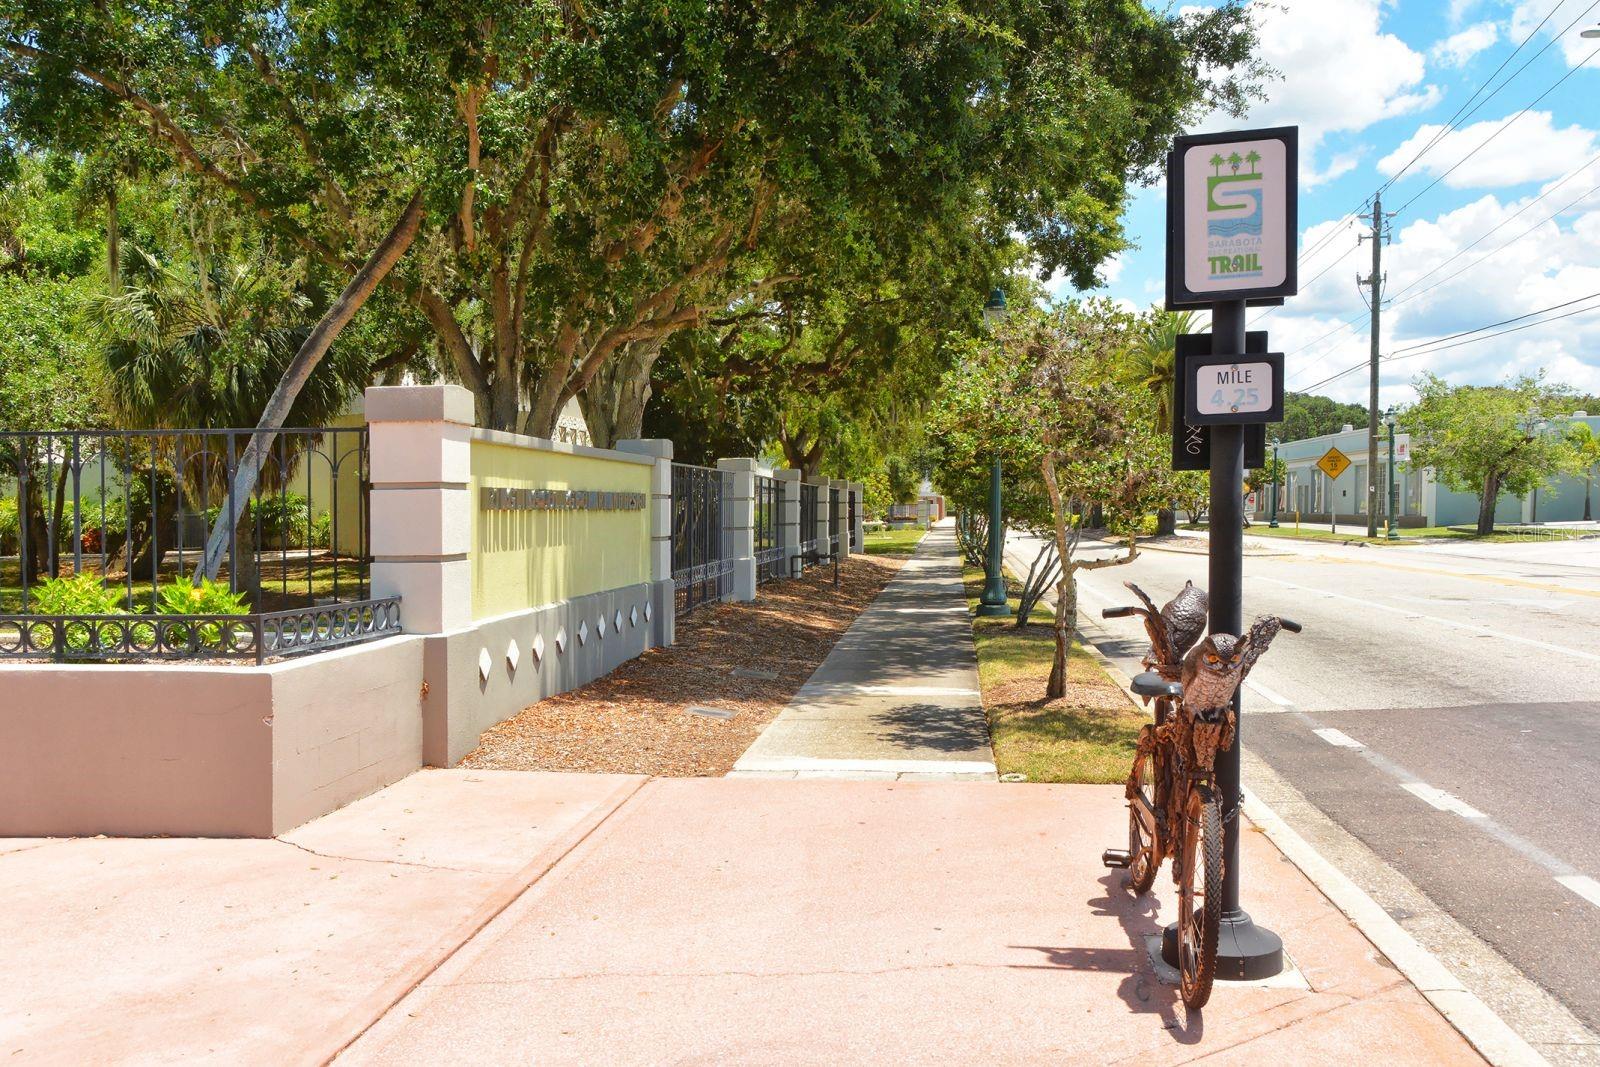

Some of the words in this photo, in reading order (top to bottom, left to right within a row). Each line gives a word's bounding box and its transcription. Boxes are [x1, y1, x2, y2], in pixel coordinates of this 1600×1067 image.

[1208, 253, 1262, 274] TRAIL
[1217, 369, 1252, 385] MILE
[1210, 388, 1260, 407] 4.25
